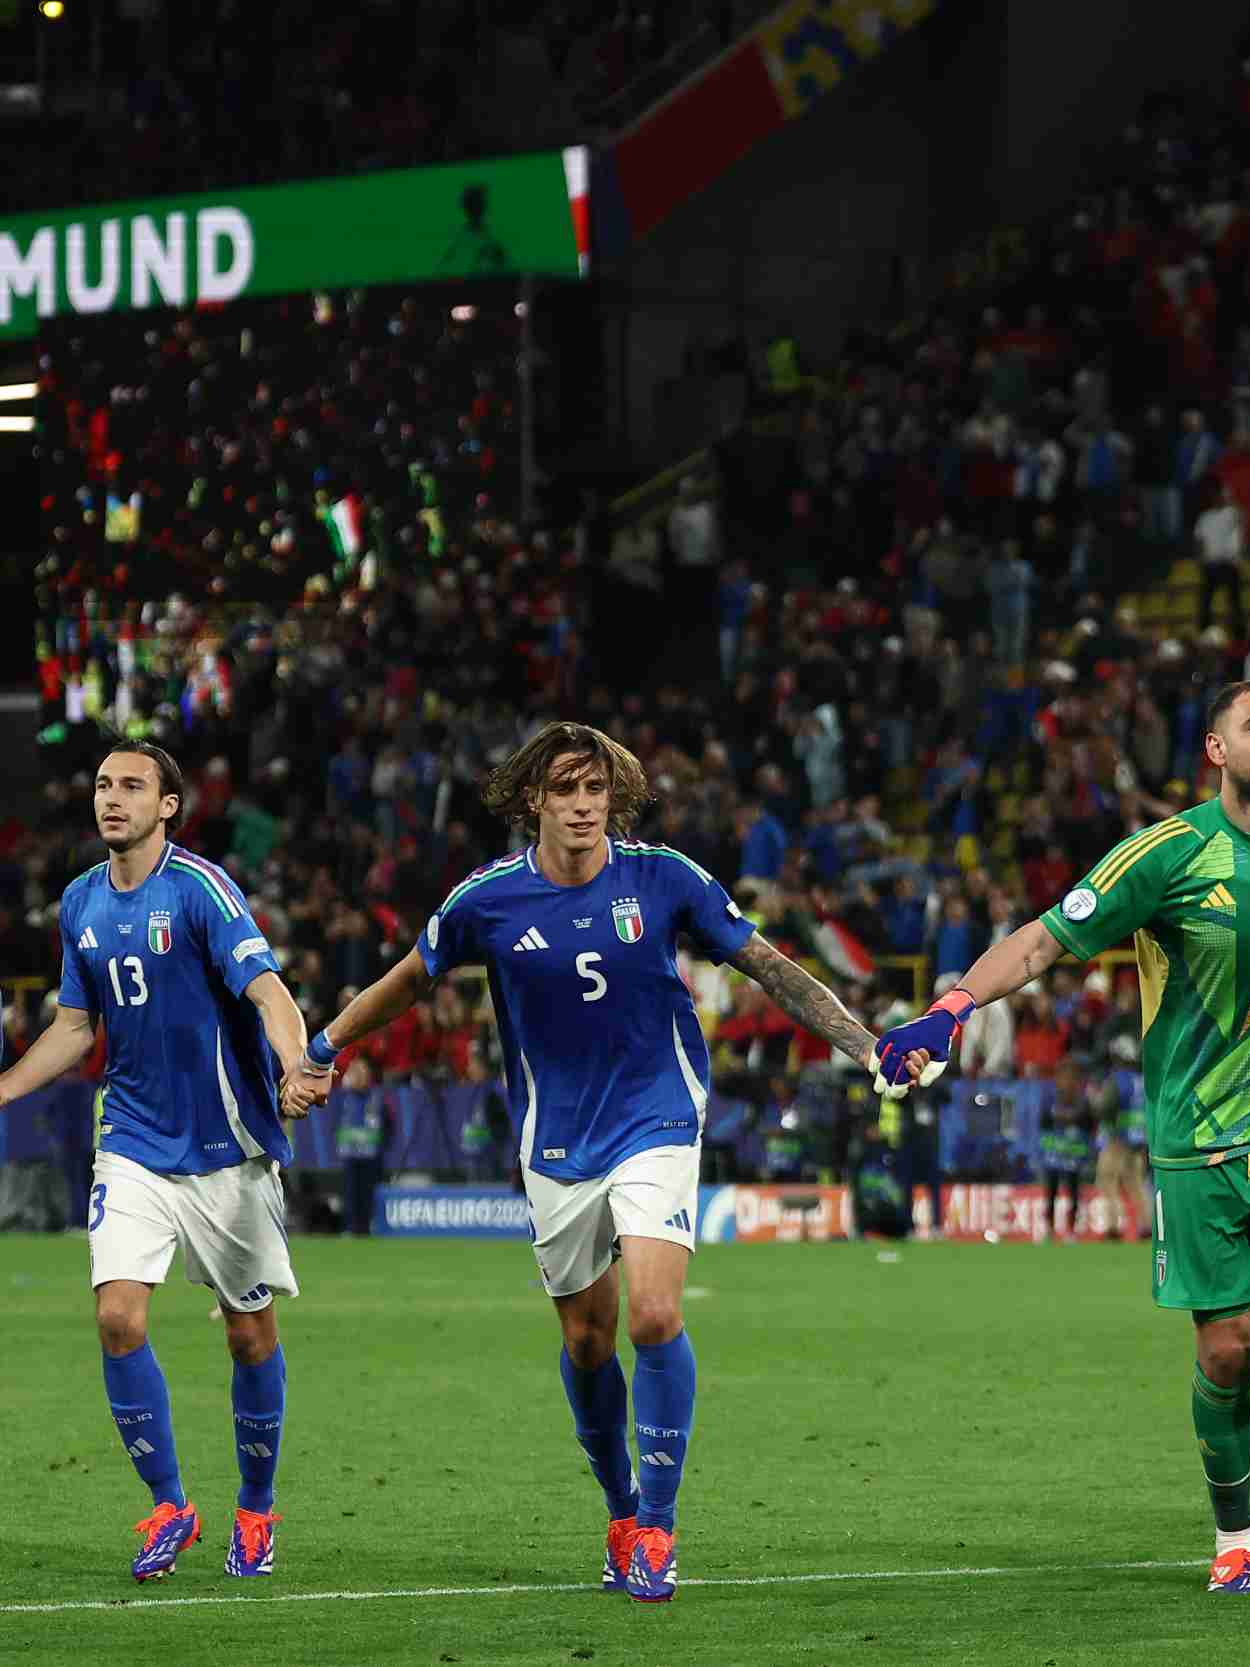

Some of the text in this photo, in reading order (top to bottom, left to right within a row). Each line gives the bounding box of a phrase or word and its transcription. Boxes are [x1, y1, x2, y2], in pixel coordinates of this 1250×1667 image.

[0, 206, 254, 326] MUND
[108, 955, 148, 1006] 13
[575, 951, 607, 1001] 5
